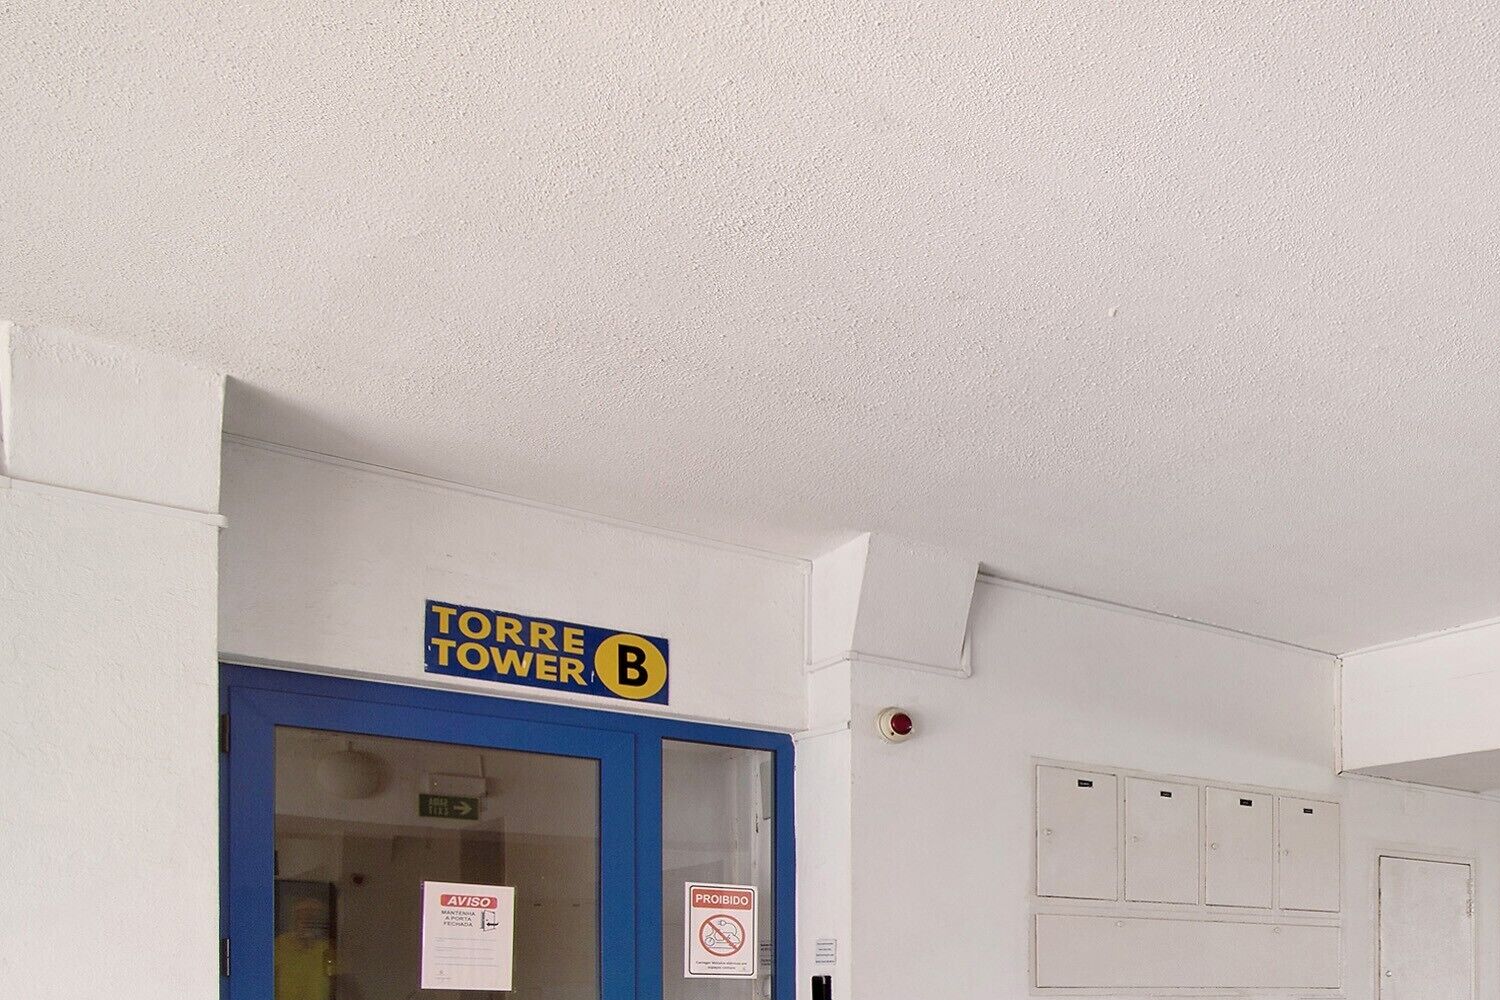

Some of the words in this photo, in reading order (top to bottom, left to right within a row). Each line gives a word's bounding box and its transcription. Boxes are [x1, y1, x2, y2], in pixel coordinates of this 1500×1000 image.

[431, 605, 585, 656] TORRE
[431, 638, 588, 686] TOWER
[618, 643, 649, 687] B
[447, 896, 491, 907] AVISO
[695, 893, 749, 906] PROIBIDO
